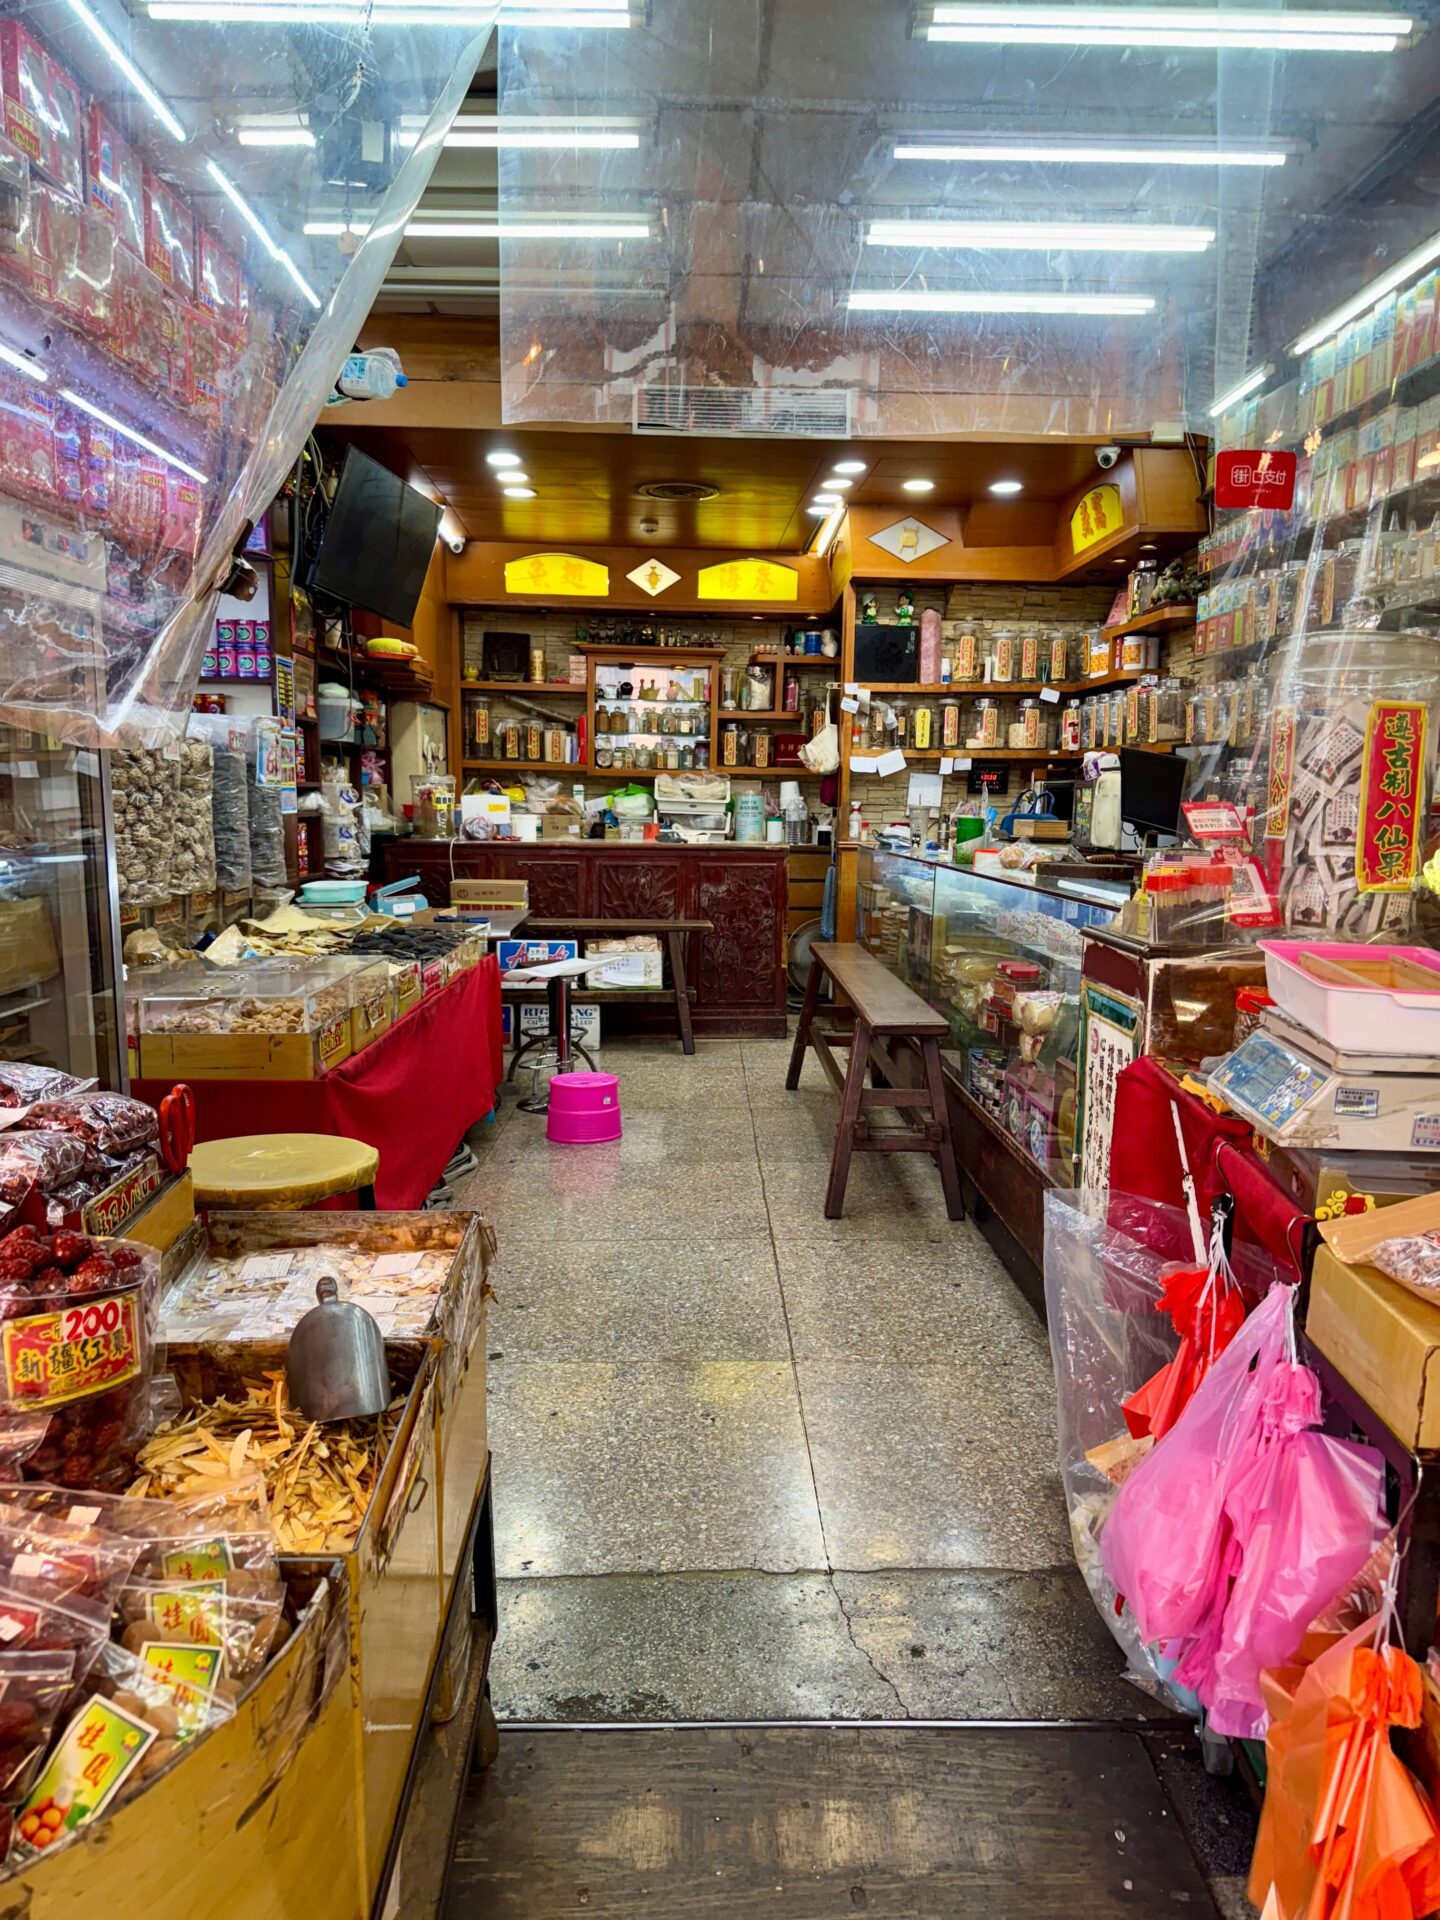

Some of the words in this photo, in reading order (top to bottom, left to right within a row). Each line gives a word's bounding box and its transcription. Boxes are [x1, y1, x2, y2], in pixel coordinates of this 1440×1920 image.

[1231, 465, 1287, 487] 街口支付
[513, 559, 586, 591] 魚翅
[1374, 712, 1416, 880] 遵古制八仙果
[66, 1301, 120, 1342] 200
[16, 1327, 131, 1383] 新疆紅棗
